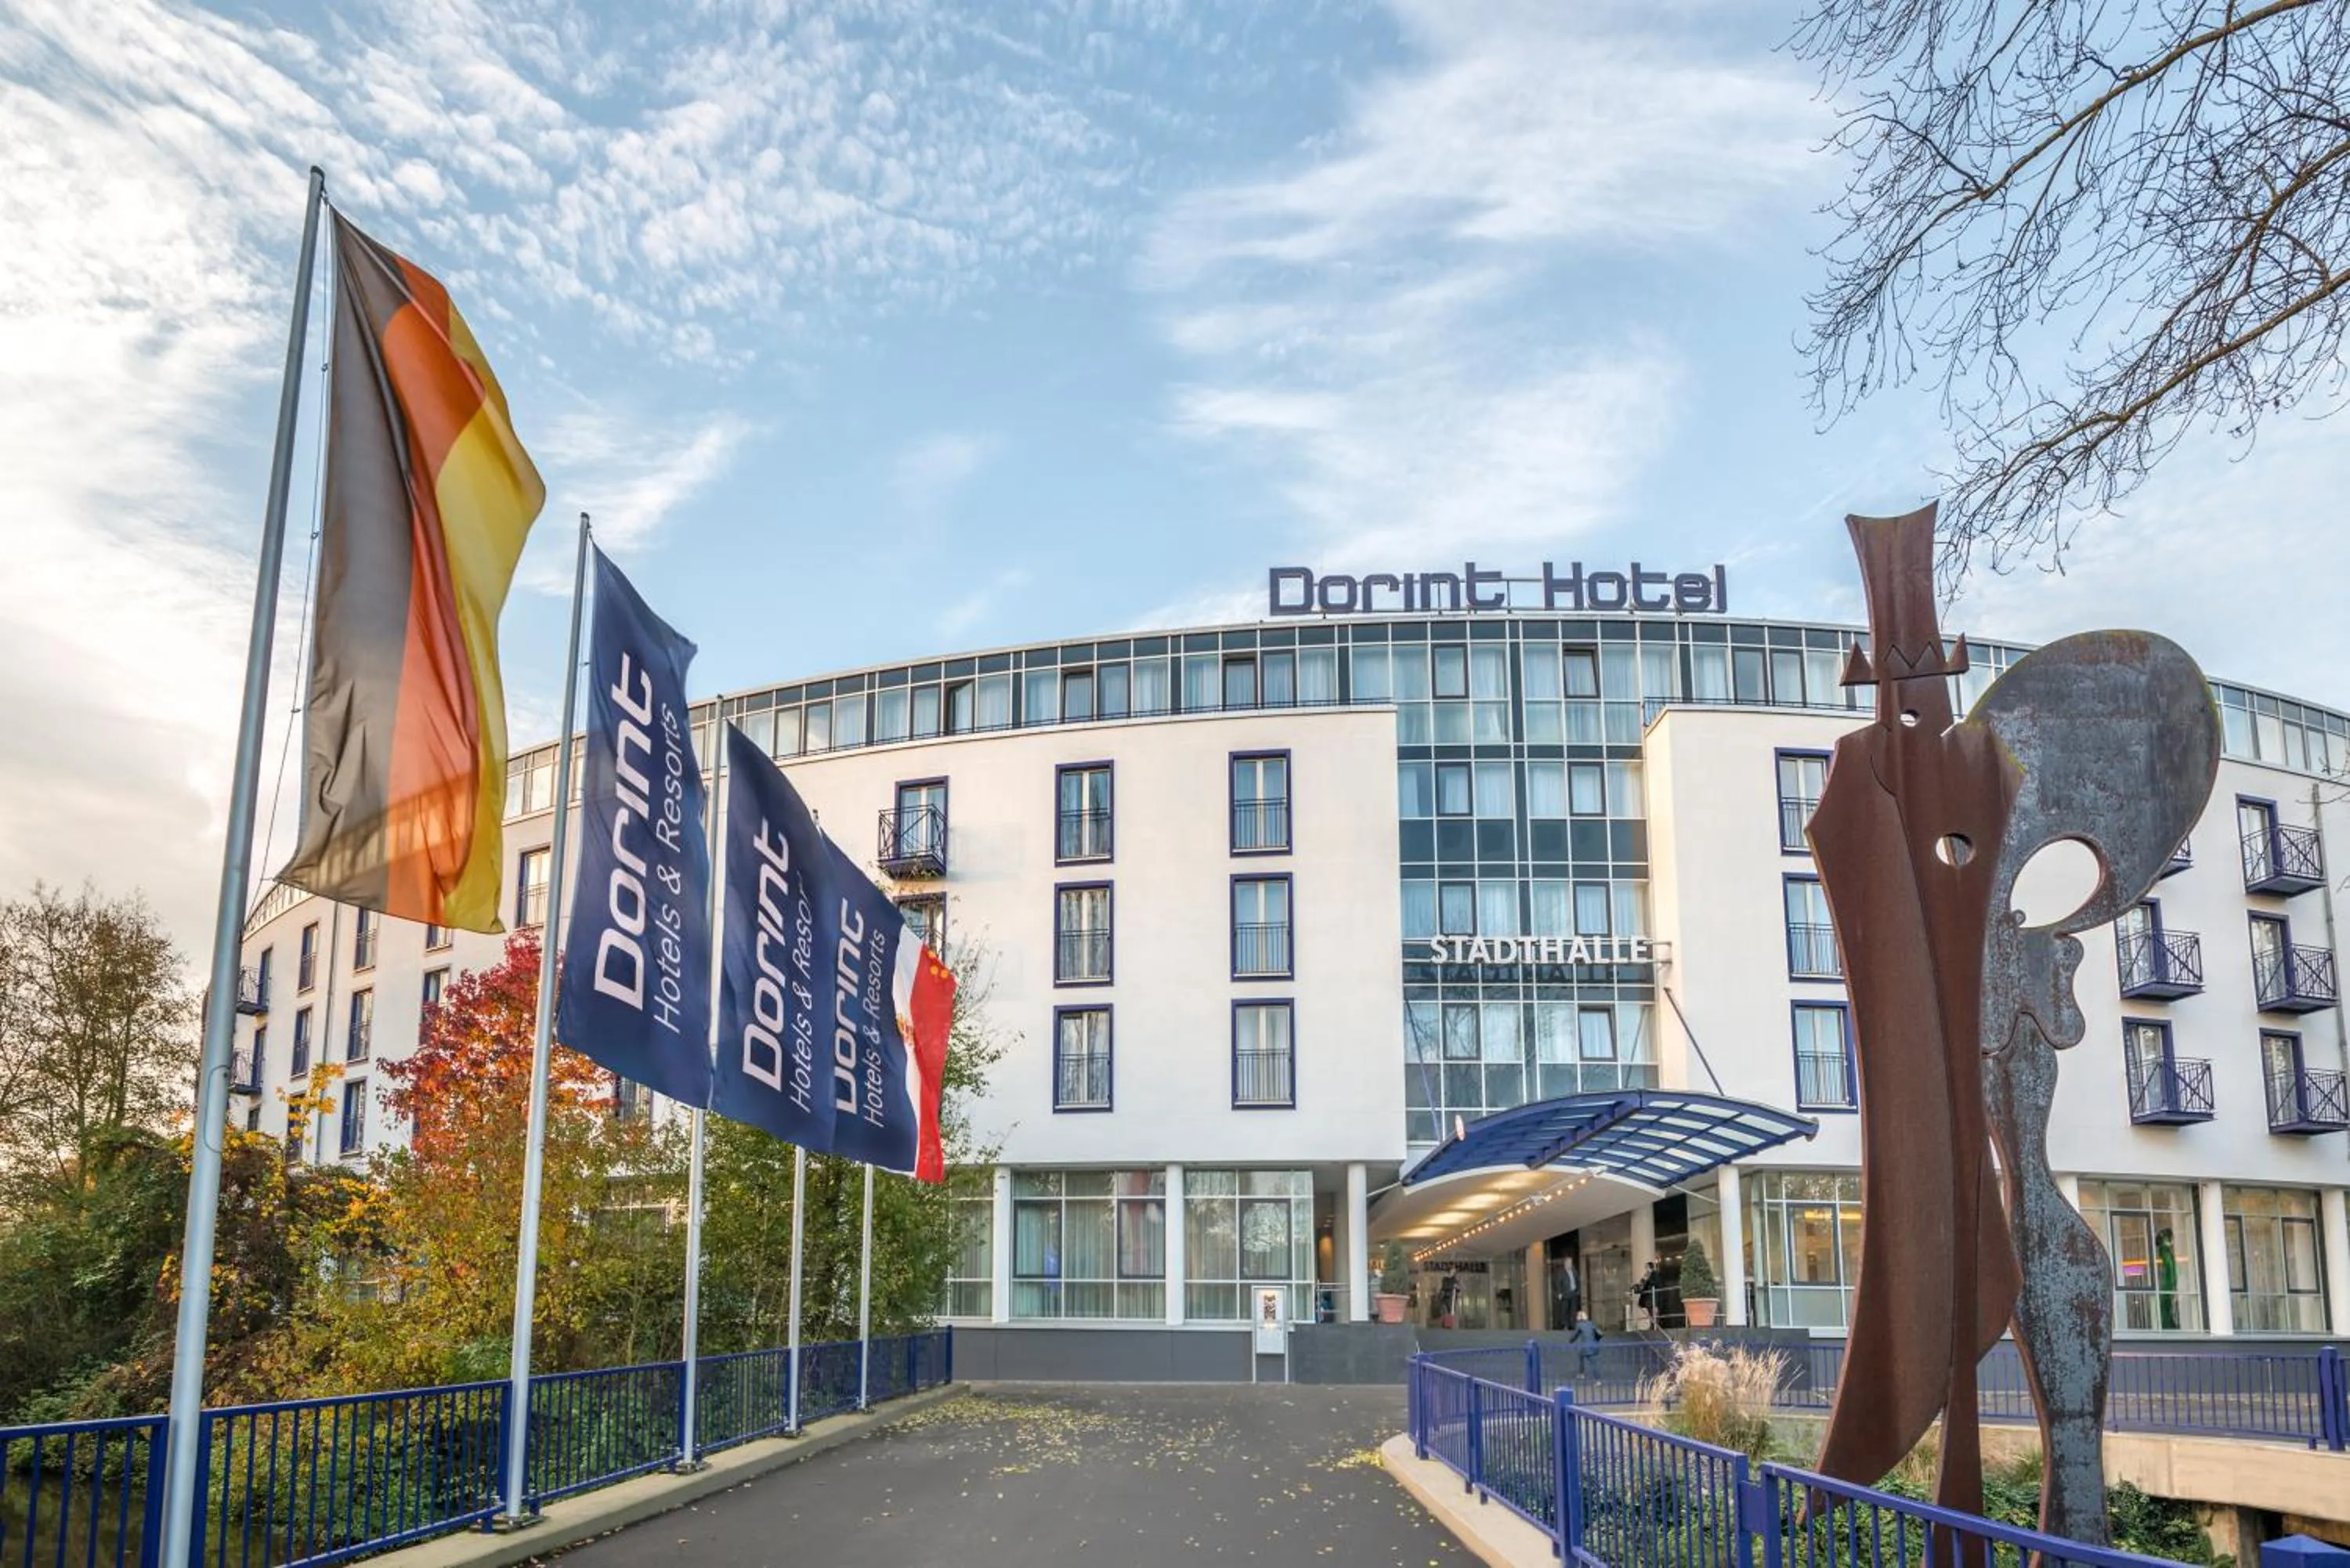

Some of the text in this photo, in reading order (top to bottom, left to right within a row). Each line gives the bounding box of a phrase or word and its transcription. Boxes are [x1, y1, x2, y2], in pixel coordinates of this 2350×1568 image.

[1269, 562, 1727, 616] Dorint Hotel
[594, 652, 653, 1010] Dorint
[653, 703, 683, 1033] Hotels & Resorts
[1430, 935, 1648, 964] STADTHALLE
[743, 816, 789, 1093] Dorint
[790, 870, 812, 1114] Hotels & Resor
[862, 929, 885, 1128] Hotels & Resorts
